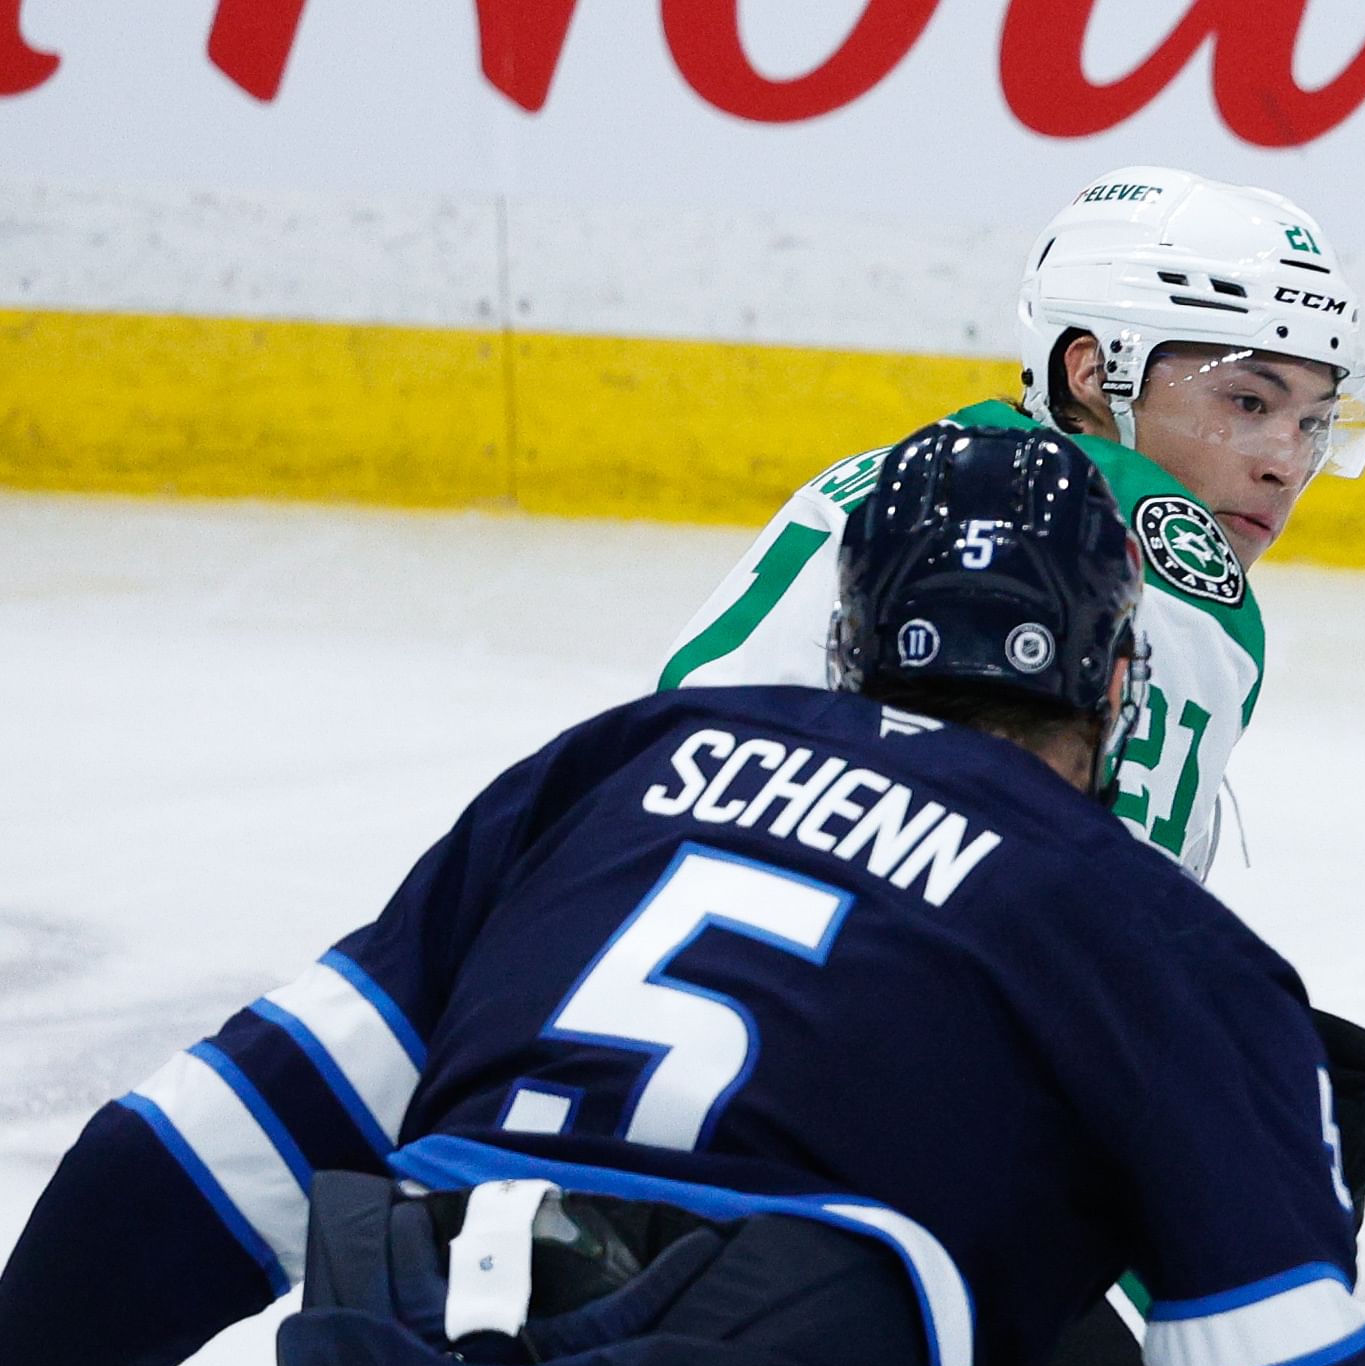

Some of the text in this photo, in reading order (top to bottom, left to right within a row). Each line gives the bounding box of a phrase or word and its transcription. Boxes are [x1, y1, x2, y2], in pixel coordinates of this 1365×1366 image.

[1273, 286, 1348, 315] CCM
[961, 519, 995, 570] 5
[1148, 502, 1240, 577] DALLAS
[1149, 536, 1234, 597] STARS
[1104, 684, 1212, 858] 21
[641, 728, 1004, 908] SCHENN
[500, 842, 855, 1153] 5
